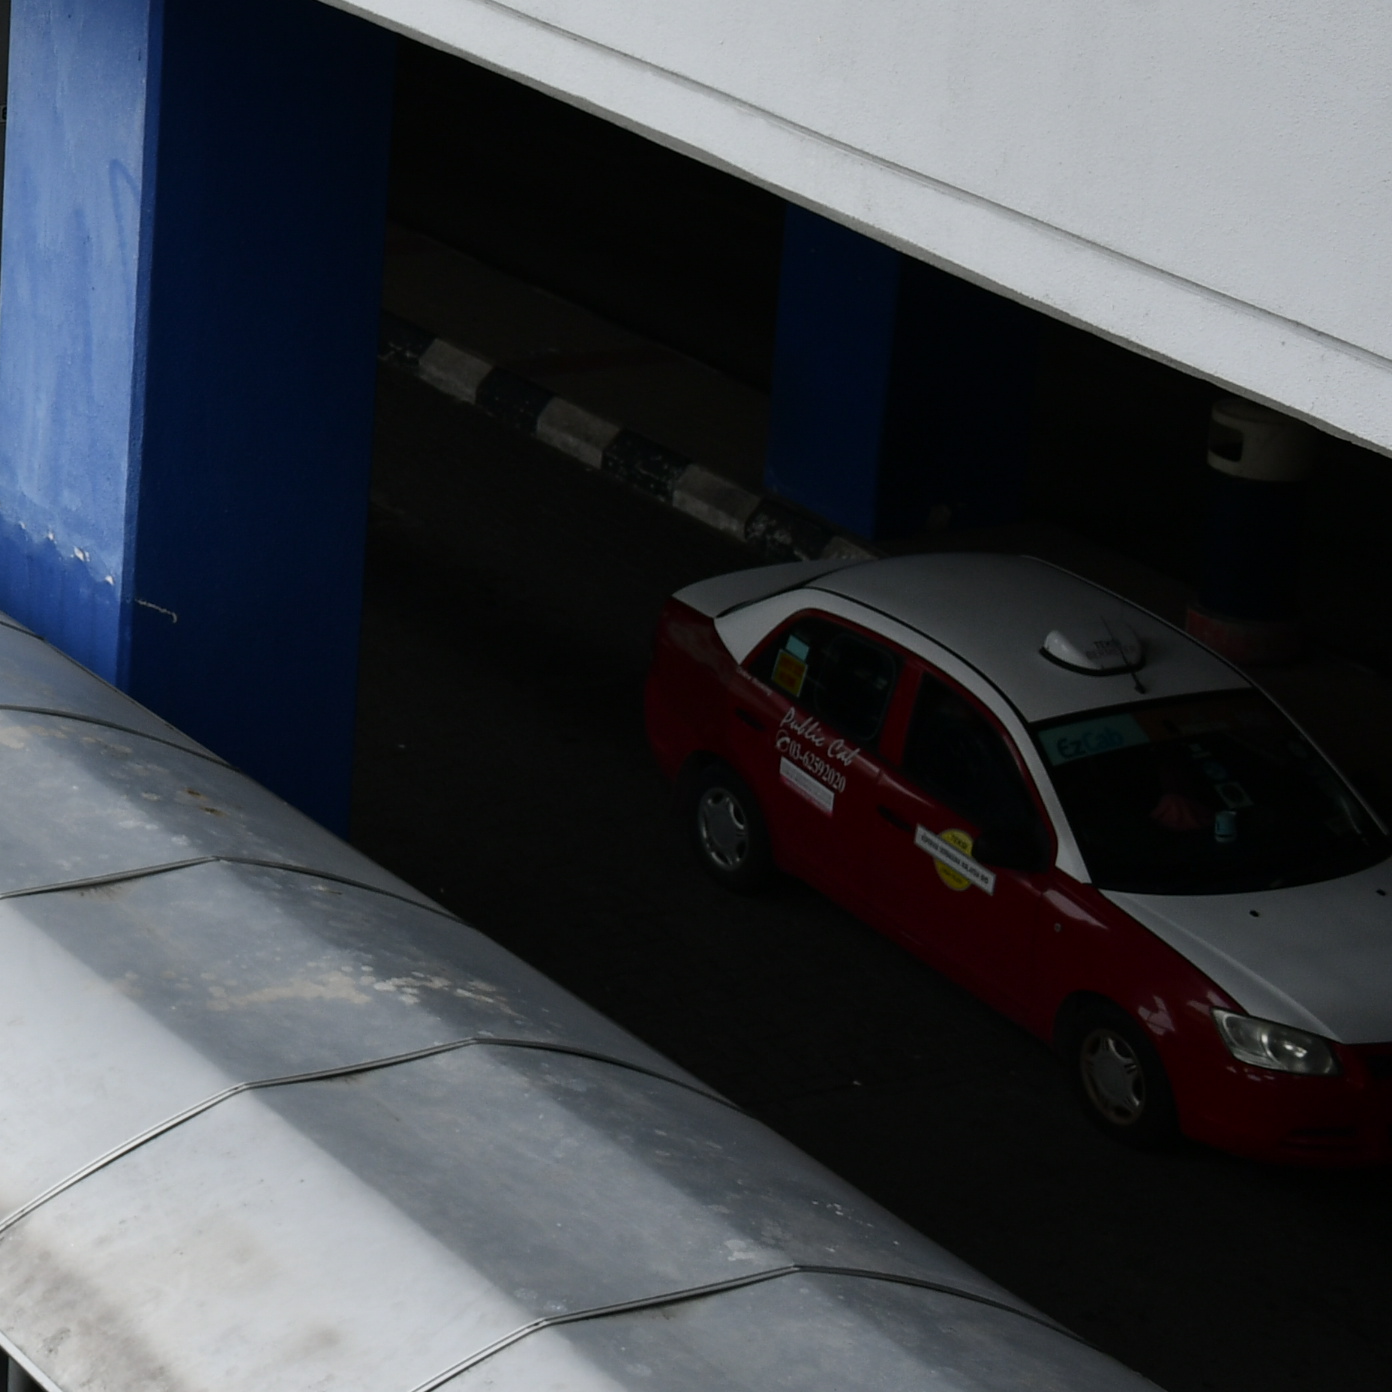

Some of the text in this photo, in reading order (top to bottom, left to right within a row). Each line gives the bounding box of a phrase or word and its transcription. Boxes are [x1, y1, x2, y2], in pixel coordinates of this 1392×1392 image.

[779, 706, 862, 767] Public Cab
[1056, 726, 1124, 758] EzCab
